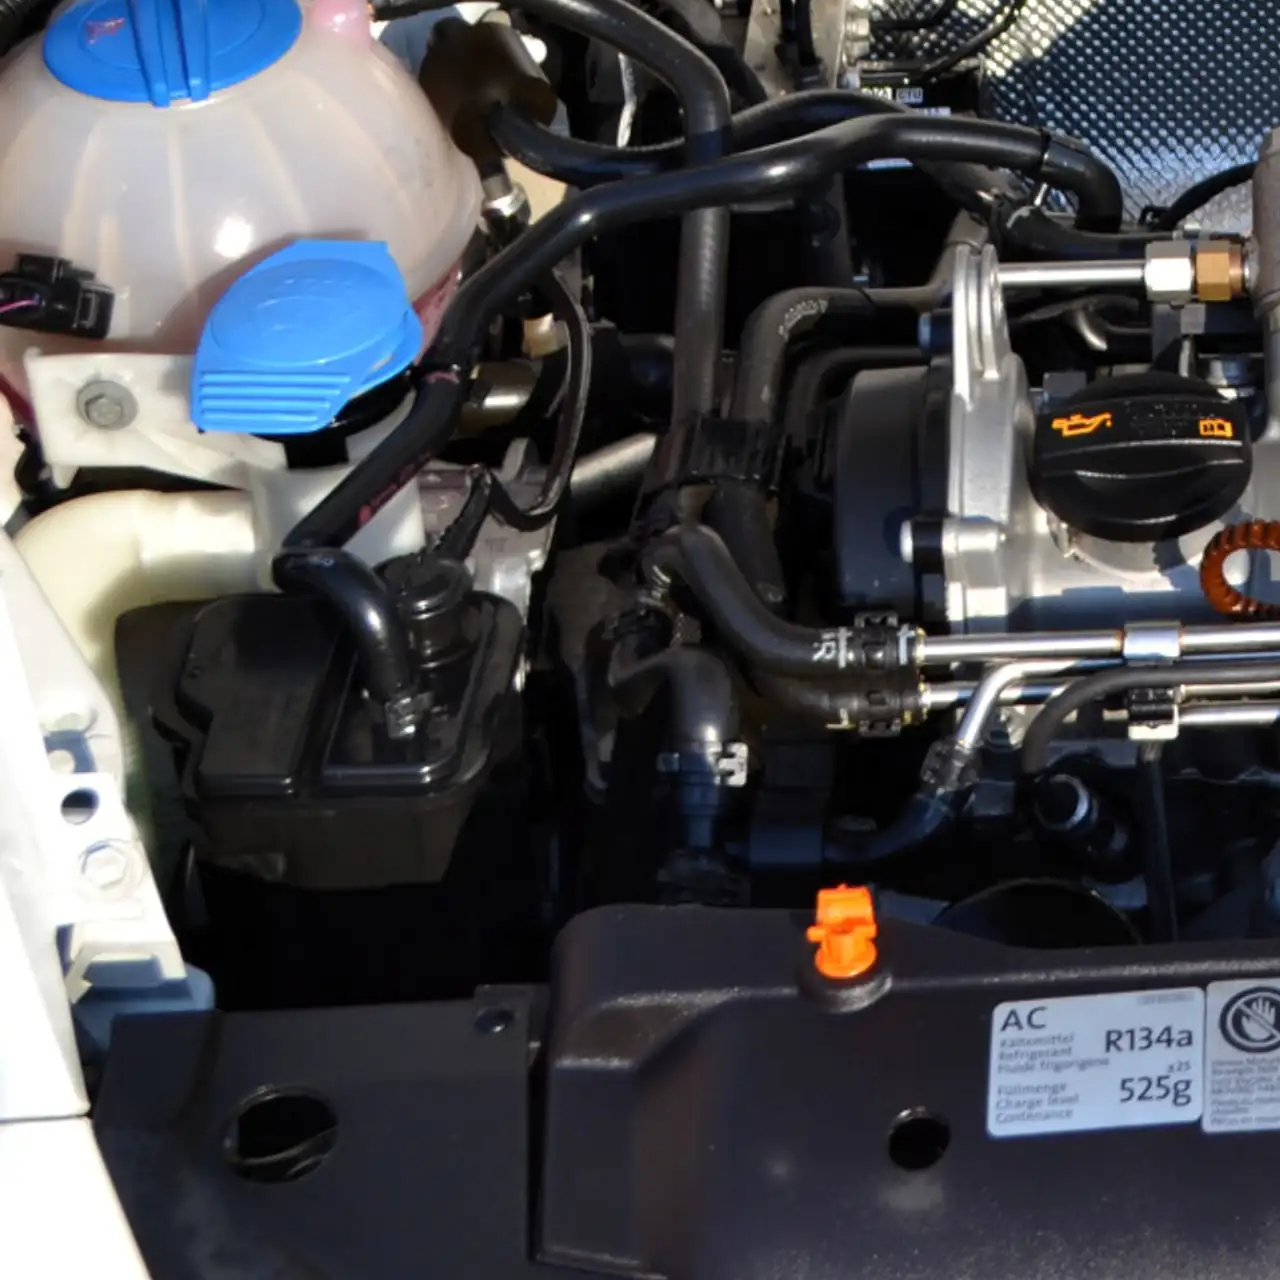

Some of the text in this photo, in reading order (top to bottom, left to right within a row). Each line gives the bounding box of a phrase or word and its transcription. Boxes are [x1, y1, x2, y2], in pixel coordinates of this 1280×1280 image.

[1001, 1005, 1048, 1032] AC
[1104, 1025, 1193, 1054] R134a
[1119, 1074, 1193, 1108] 525g
